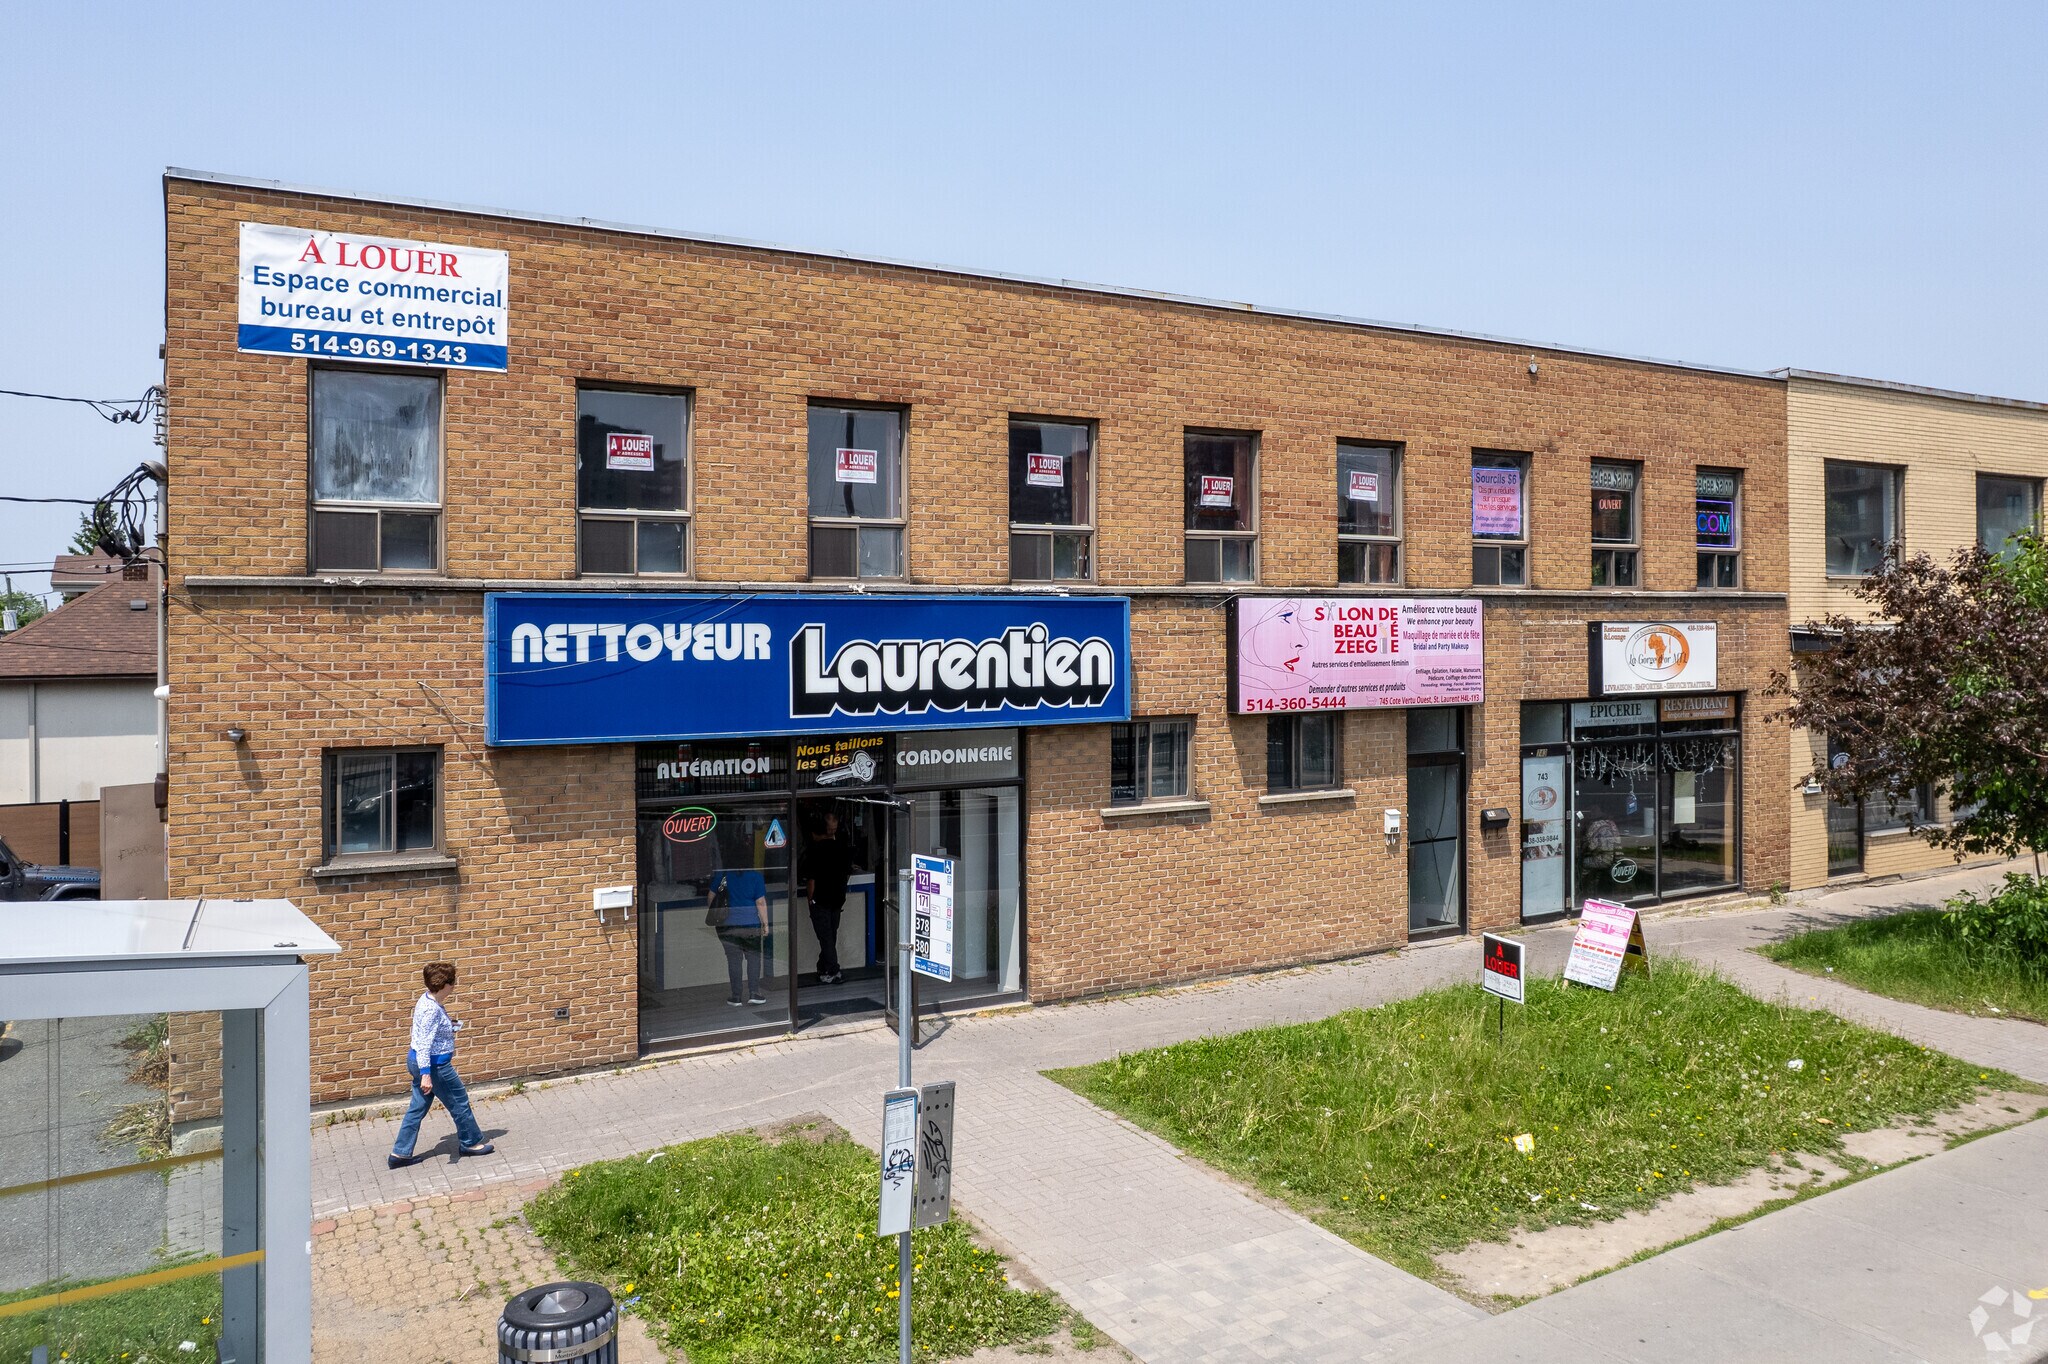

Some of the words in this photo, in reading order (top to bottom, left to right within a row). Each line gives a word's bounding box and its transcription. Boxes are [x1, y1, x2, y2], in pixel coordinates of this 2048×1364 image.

[298, 235, 327, 264] À
[335, 241, 462, 278] LOUER
[253, 265, 349, 293] Espace
[358, 279, 502, 308] commercial
[260, 295, 351, 323] bureau
[360, 307, 384, 326] et
[392, 311, 496, 337] entrepôt
[290, 332, 467, 364] 514-969-1343
[622, 438, 650, 452] LOUER
[849, 453, 874, 466] LOUER
[1039, 458, 1060, 470] LOUER
[1211, 480, 1230, 491] LOUER
[1359, 476, 1375, 487] LOUER
[1475, 472, 1505, 484] Sourcils
[1507, 474, 1517, 485] $6
[1599, 499, 1622, 510] OUVERT
[1379, 607, 1398, 621] DE
[1402, 604, 1435, 613] Améliorez
[1455, 604, 1477, 614] beauté
[1407, 617, 1416, 625] We
[1417, 617, 1440, 625] enhance
[1441, 618, 1454, 626] your
[1455, 617, 1474, 626] beauty
[511, 622, 771, 664] NETTOYEUR
[1403, 630, 1431, 642] Maquillage
[1432, 630, 1438, 639] de
[1439, 630, 1456, 639] mariée
[1457, 631, 1463, 639] et
[1463, 630, 1469, 639] de
[1413, 642, 1427, 650] Bridal
[1428, 642, 1437, 650] and
[1438, 642, 1450, 651] Party
[1451, 642, 1469, 651] Makeup
[797, 622, 1112, 706] Laurentien
[1349, 660, 1390, 668] d'embellissement
[1391, 659, 1409, 667] féminin
[1308, 684, 1336, 694] Demander
[1336, 683, 1357, 693] d'autres
[1358, 684, 1379, 692] services
[1379, 684, 1384, 692] et
[1384, 682, 1406, 693] produits
[1246, 695, 1347, 712] 514-360-5444
[1379, 697, 1388, 705] 745
[1401, 696, 1416, 704] Vertu
[1440, 694, 1460, 703] Laurent
[1461, 694, 1480, 702] H4L-1Y3
[1663, 696, 1729, 712] RESTAURANT
[1590, 702, 1642, 718] ÉPICERIE
[796, 743, 831, 757] Nous
[835, 735, 883, 754] taillons
[796, 757, 818, 771] les
[820, 753, 849, 769] clés
[896, 745, 1013, 767] CORDONNERIE
[657, 756, 770, 780] ALTÉRATION
[1537, 772, 1549, 780] 743
[665, 815, 713, 835] OUVERT
[1527, 834, 1559, 845] 38-338-9844
[918, 872, 929, 886] 121
[918, 894, 929, 907] 171
[915, 917, 930, 932] 378
[915, 939, 929, 954] 380
[1485, 954, 1519, 978] LOUER
[555, 1351, 577, 1360] Montréal
